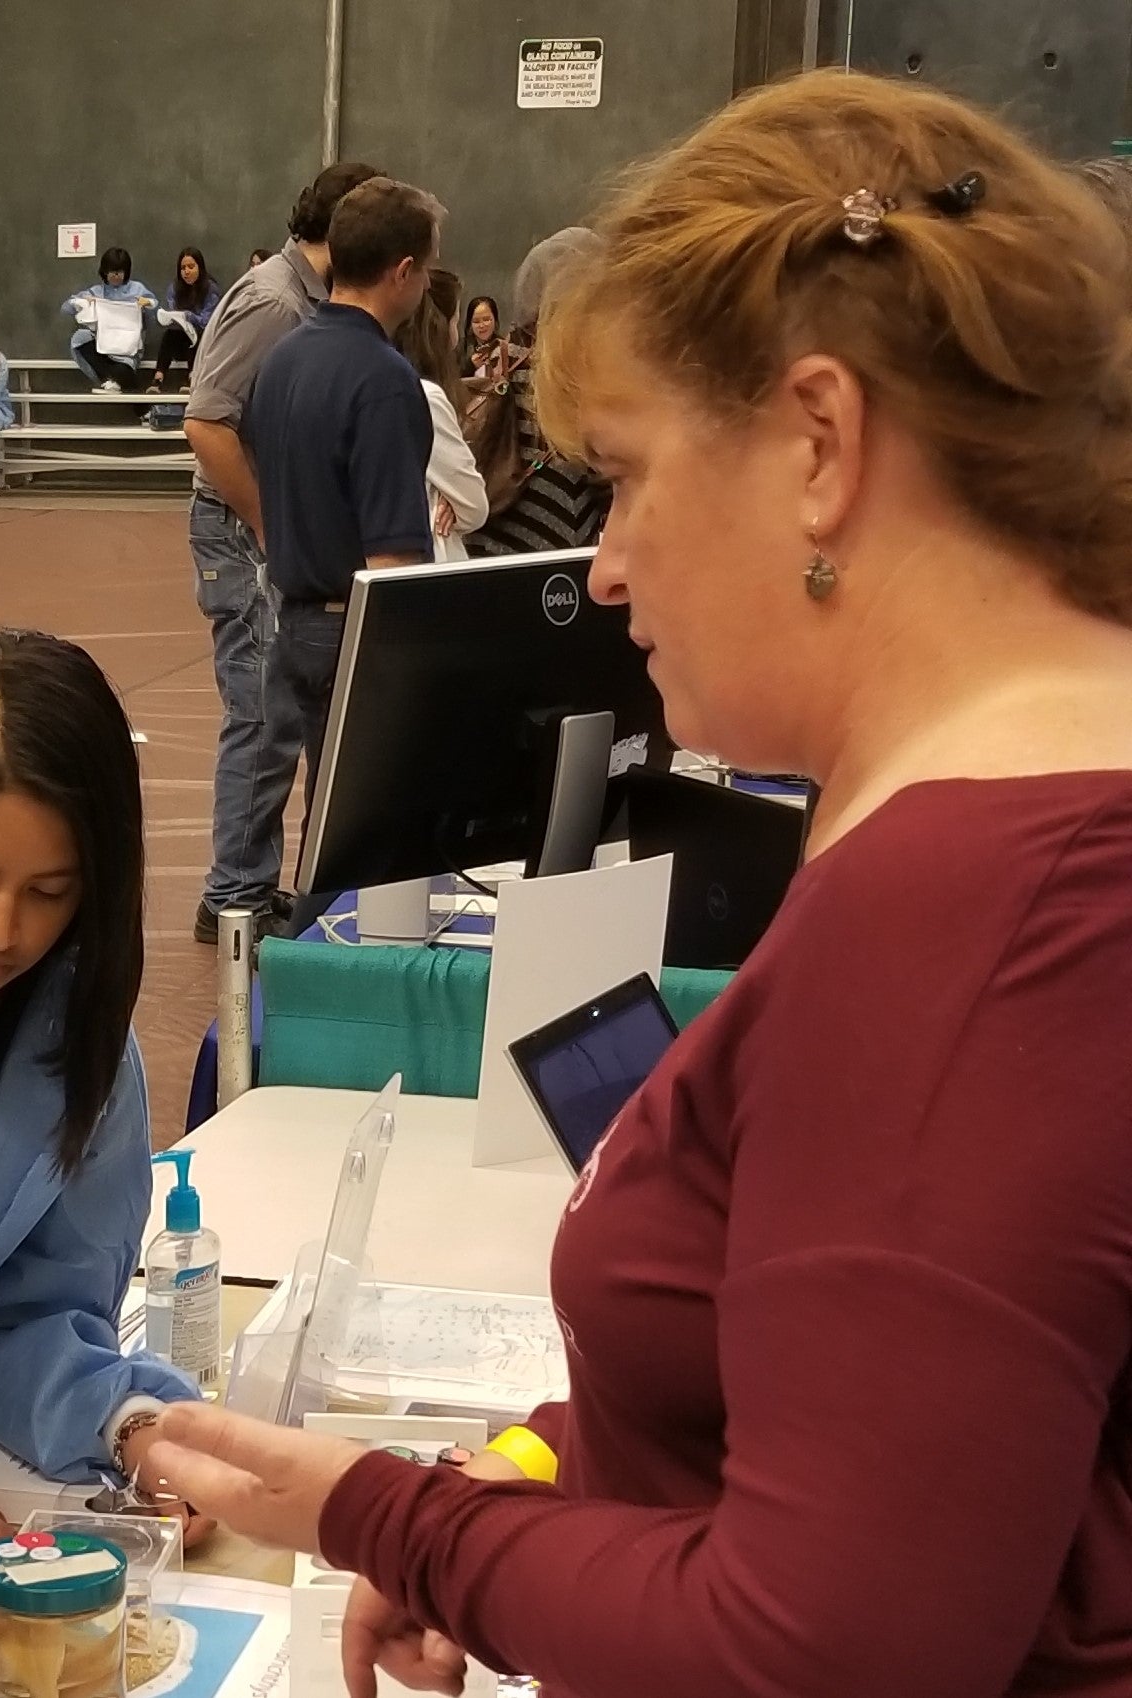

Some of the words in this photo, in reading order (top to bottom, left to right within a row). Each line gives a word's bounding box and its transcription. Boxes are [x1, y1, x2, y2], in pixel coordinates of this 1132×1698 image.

[526, 52, 550, 62] GLASS
[550, 51, 596, 61] CONTAINERS
[522, 64, 556, 72] ALLOWED
[557, 63, 566, 71] IN
[567, 62, 598, 71] FACILITY
[535, 74, 570, 82] BEVERAGES
[546, 592, 576, 608] DELL
